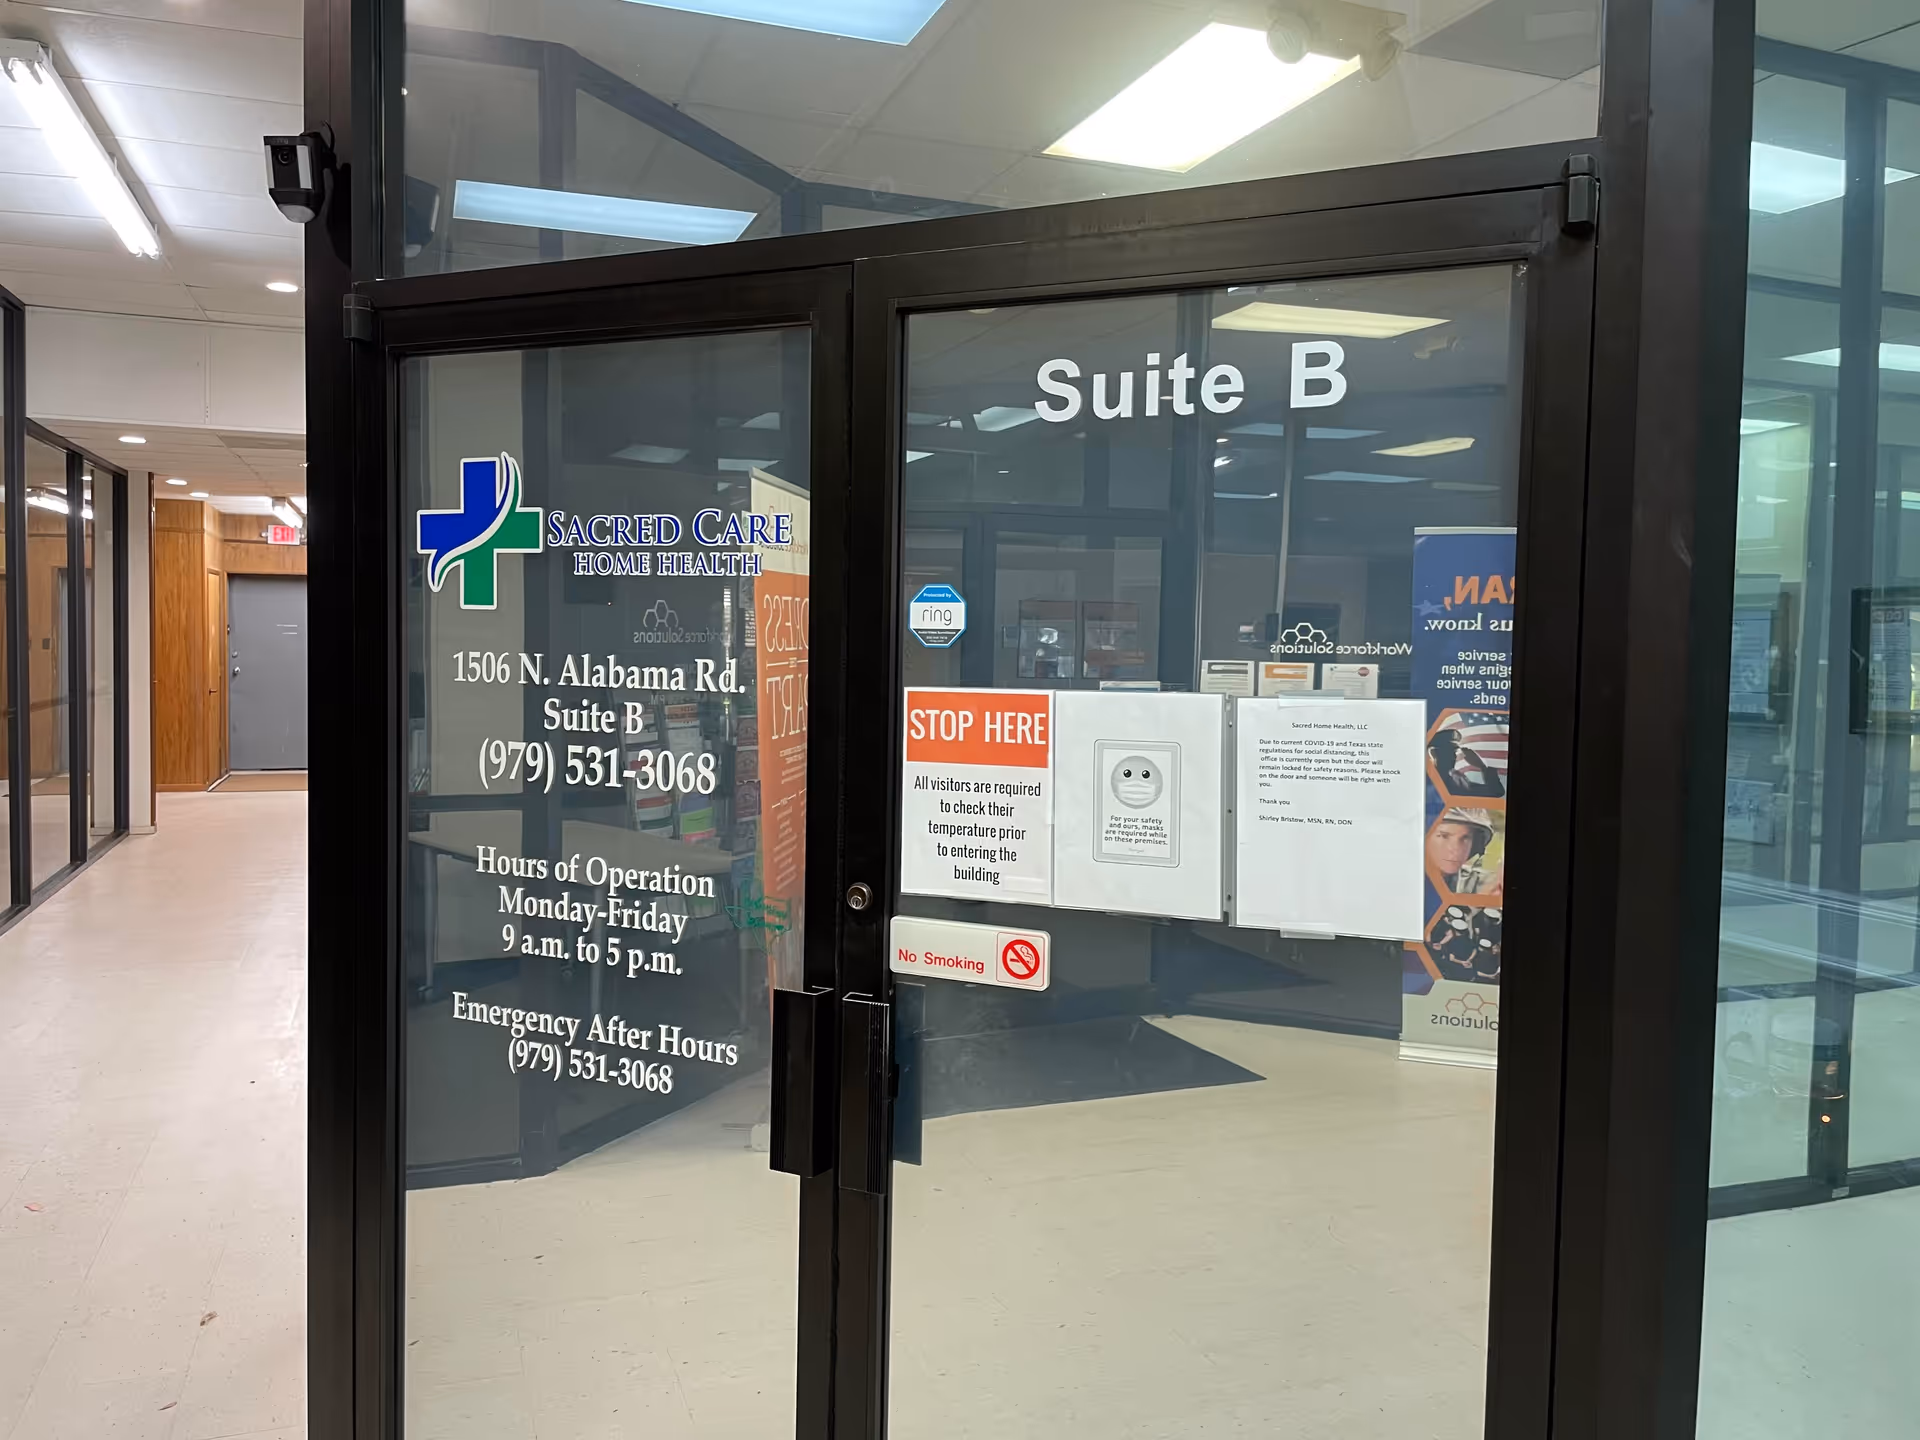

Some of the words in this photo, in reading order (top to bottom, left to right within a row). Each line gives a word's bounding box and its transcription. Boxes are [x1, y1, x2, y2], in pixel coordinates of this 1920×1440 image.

[1034, 352, 1245, 422] Suite
[1289, 340, 1348, 409] B
[573, 551, 651, 576] HOME
[656, 551, 763, 577] HEALTH
[922, 605, 952, 626] ring
[453, 651, 510, 683] 1506
[518, 653, 549, 686] N.
[558, 653, 686, 692] Alabama
[694, 657, 746, 694] Rd.
[543, 697, 616, 733] Suite
[624, 702, 643, 735] B
[910, 708, 974, 742] STOP
[984, 711, 1047, 745] HERE
[1333, 723, 1355, 731] Health,
[1259, 747, 1293, 755] regulations
[1323, 749, 1357, 757] distancing,
[1285, 756, 1312, 764] currently
[1314, 757, 1330, 765] open
[478, 737, 554, 794] (979)
[565, 744, 716, 795] 531-3068
[914, 775, 929, 790] All
[930, 776, 972, 794] visitors
[973, 780, 991, 794] are
[994, 781, 1041, 798] required
[1360, 776, 1375, 784] right
[940, 799, 951, 814] to
[953, 799, 986, 816] check
[987, 801, 1015, 817] their
[1259, 815, 1279, 823] Shirley
[1307, 817, 1324, 825] MSN,
[928, 820, 997, 841] temperature
[998, 825, 1027, 842] prior
[1141, 817, 1163, 825] safety
[936, 843, 948, 858] to
[950, 843, 997, 864] entering
[998, 846, 1018, 862] the
[476, 844, 548, 881] Hours
[554, 853, 580, 883] of
[585, 856, 715, 898] Operation
[953, 865, 1001, 886] building
[498, 885, 689, 945] Monday-Friday
[502, 923, 516, 952] 9
[520, 933, 570, 960] a.m.
[576, 936, 600, 965] to
[606, 937, 621, 966] 5
[626, 945, 684, 978] p.m.
[898, 949, 917, 963] No
[923, 952, 985, 974] Smoking
[452, 991, 580, 1047] Emergency
[586, 1013, 652, 1052] After
[657, 1024, 739, 1067] Hours
[508, 1037, 562, 1082] (979)
[567, 1048, 674, 1095] 531-3068
